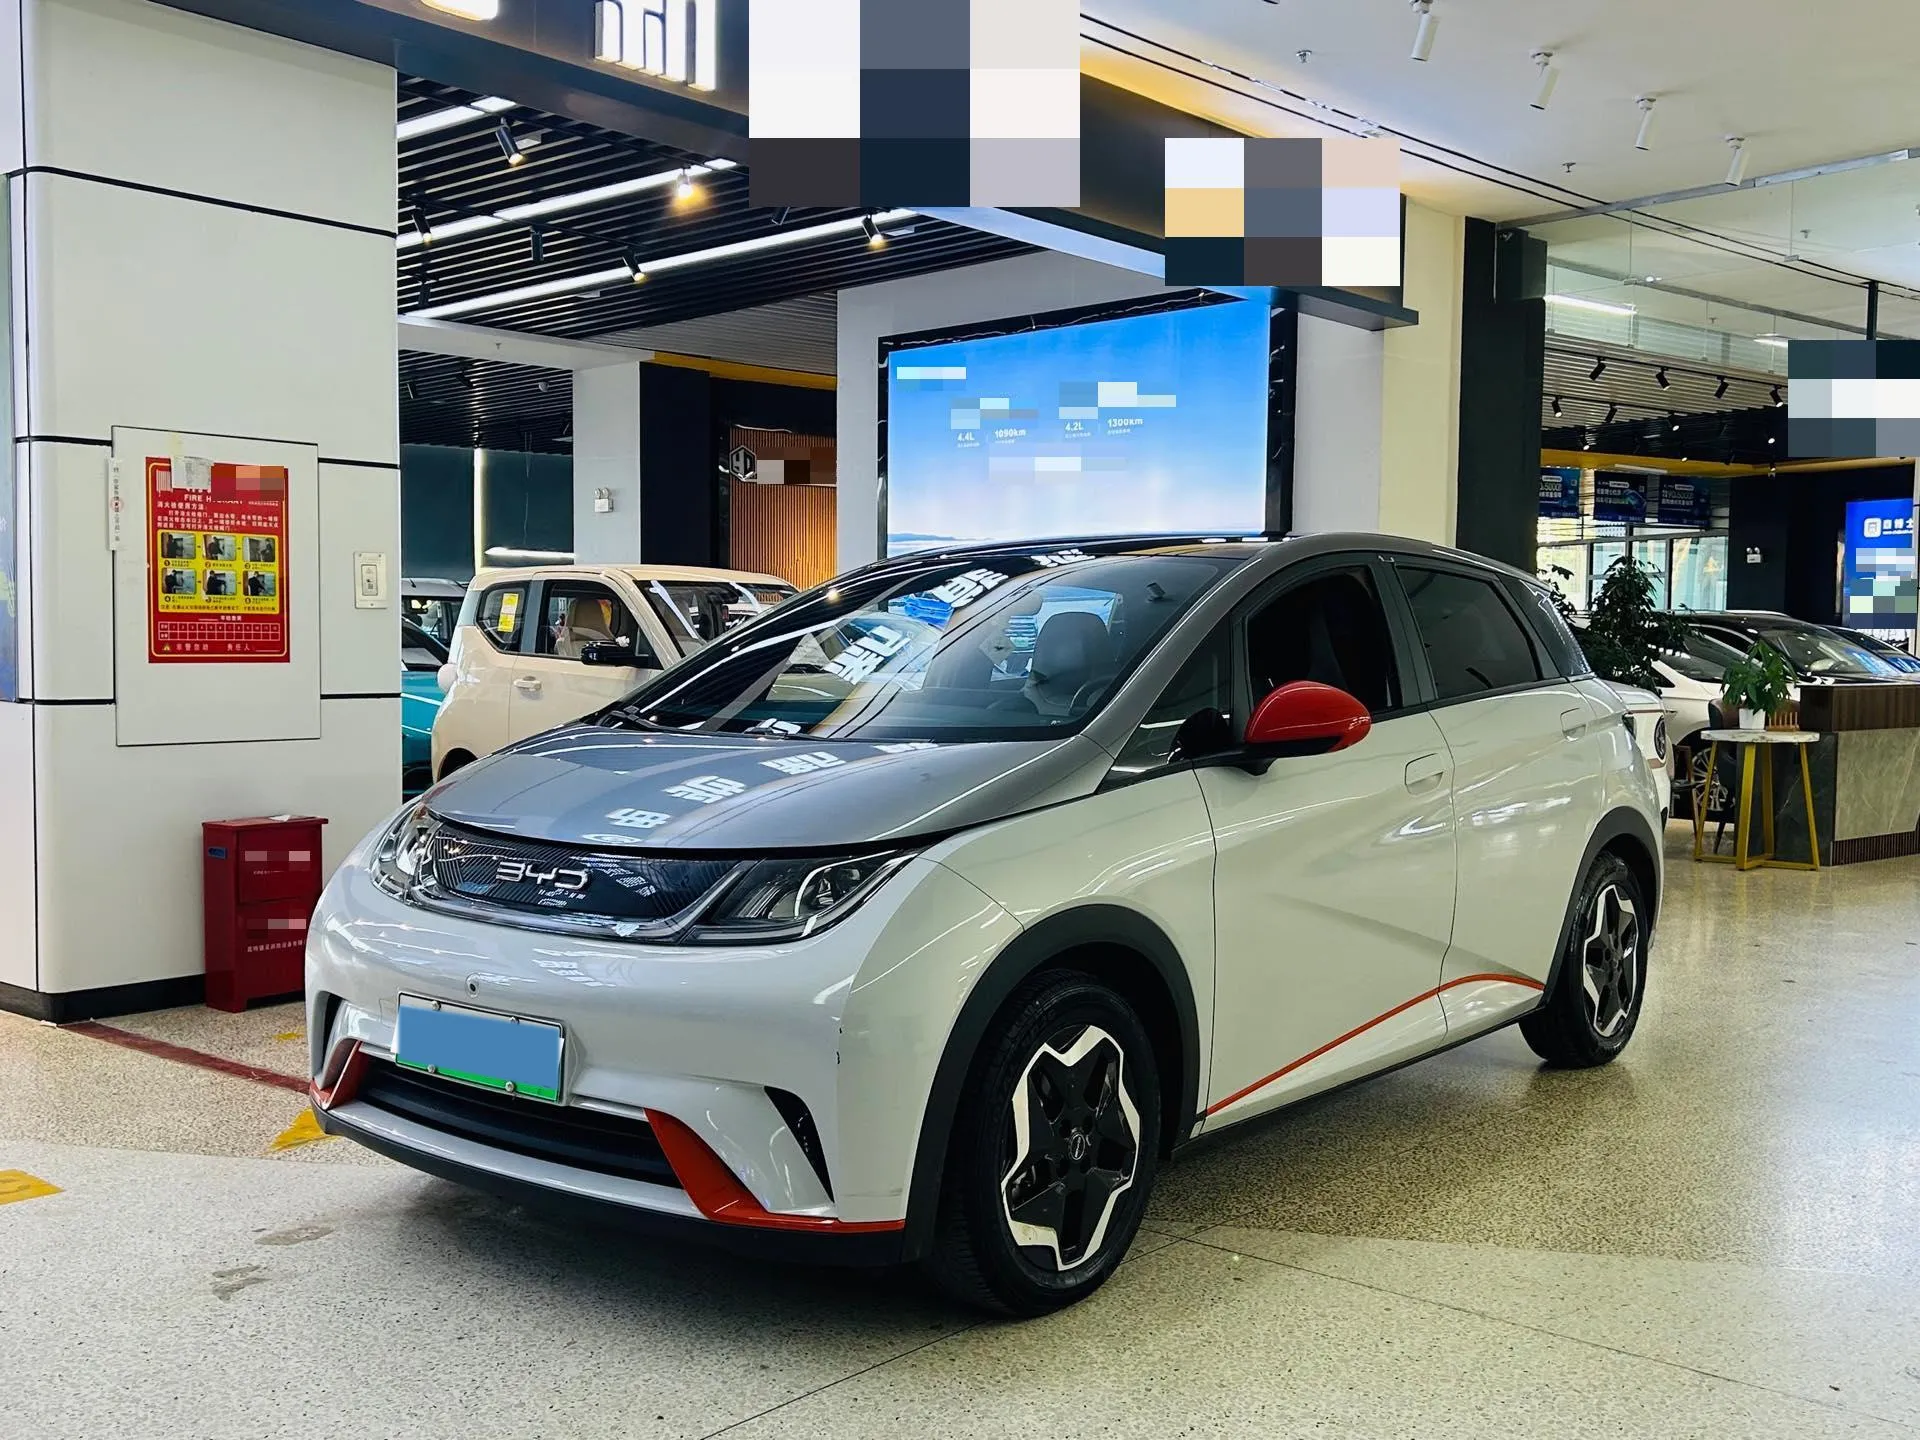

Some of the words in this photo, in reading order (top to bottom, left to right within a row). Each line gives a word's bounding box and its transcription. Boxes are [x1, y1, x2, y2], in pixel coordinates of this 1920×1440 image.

[1065, 421, 1084, 432] 4.2L
[1107, 416, 1144, 428] 1300km
[957, 431, 975, 442] 4.4L
[184, 494, 203, 502] FIRE
[495, 860, 590, 891] BYD
